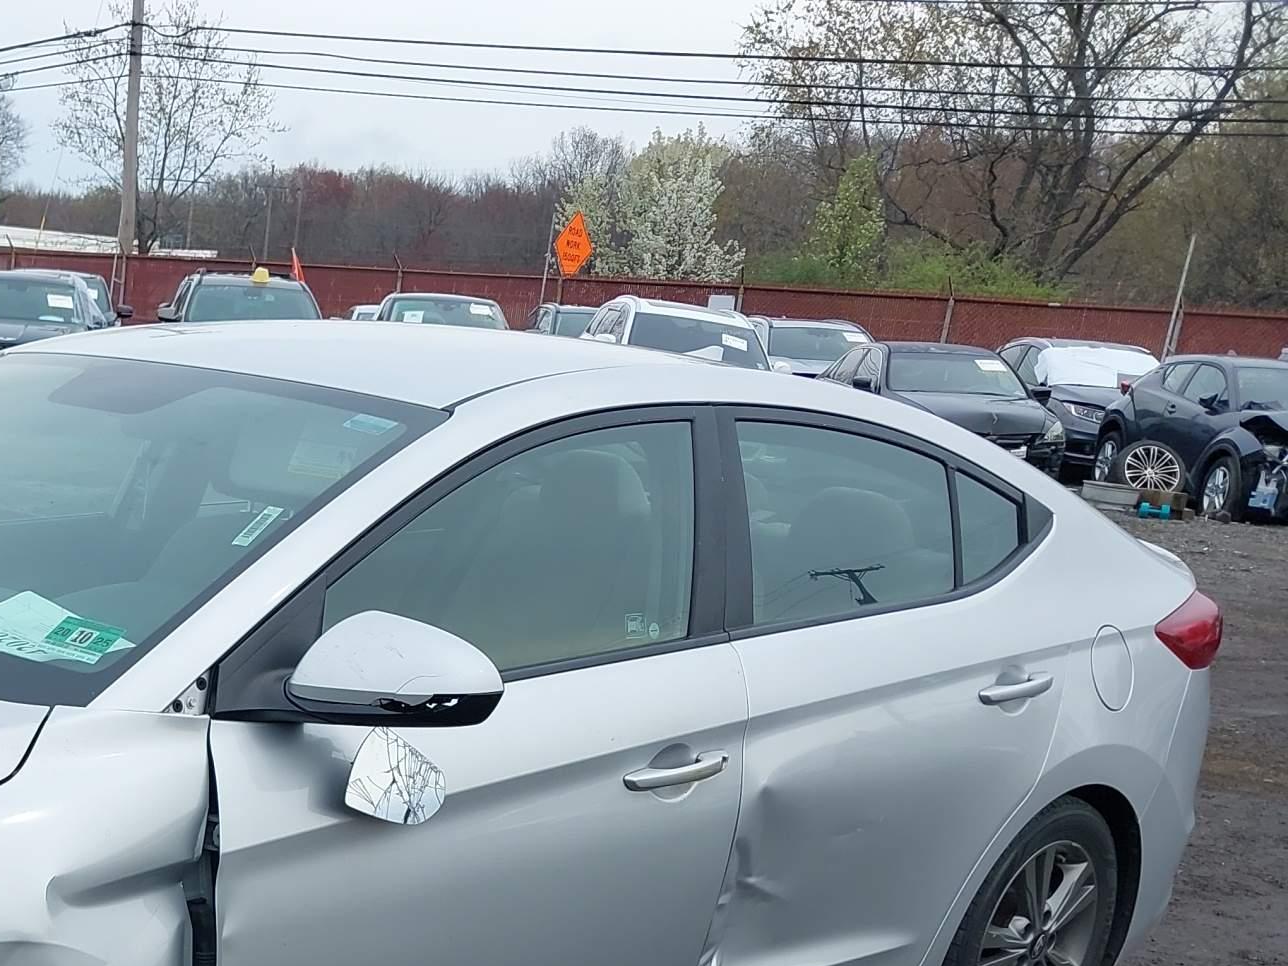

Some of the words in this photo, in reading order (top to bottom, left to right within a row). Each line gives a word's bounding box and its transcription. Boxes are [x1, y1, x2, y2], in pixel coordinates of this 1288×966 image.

[568, 225, 583, 238] ROAD
[566, 239, 580, 250] WORK
[53, 626, 72, 637] 20
[70, 630, 95, 645] 10
[92, 637, 113, 648] 25
